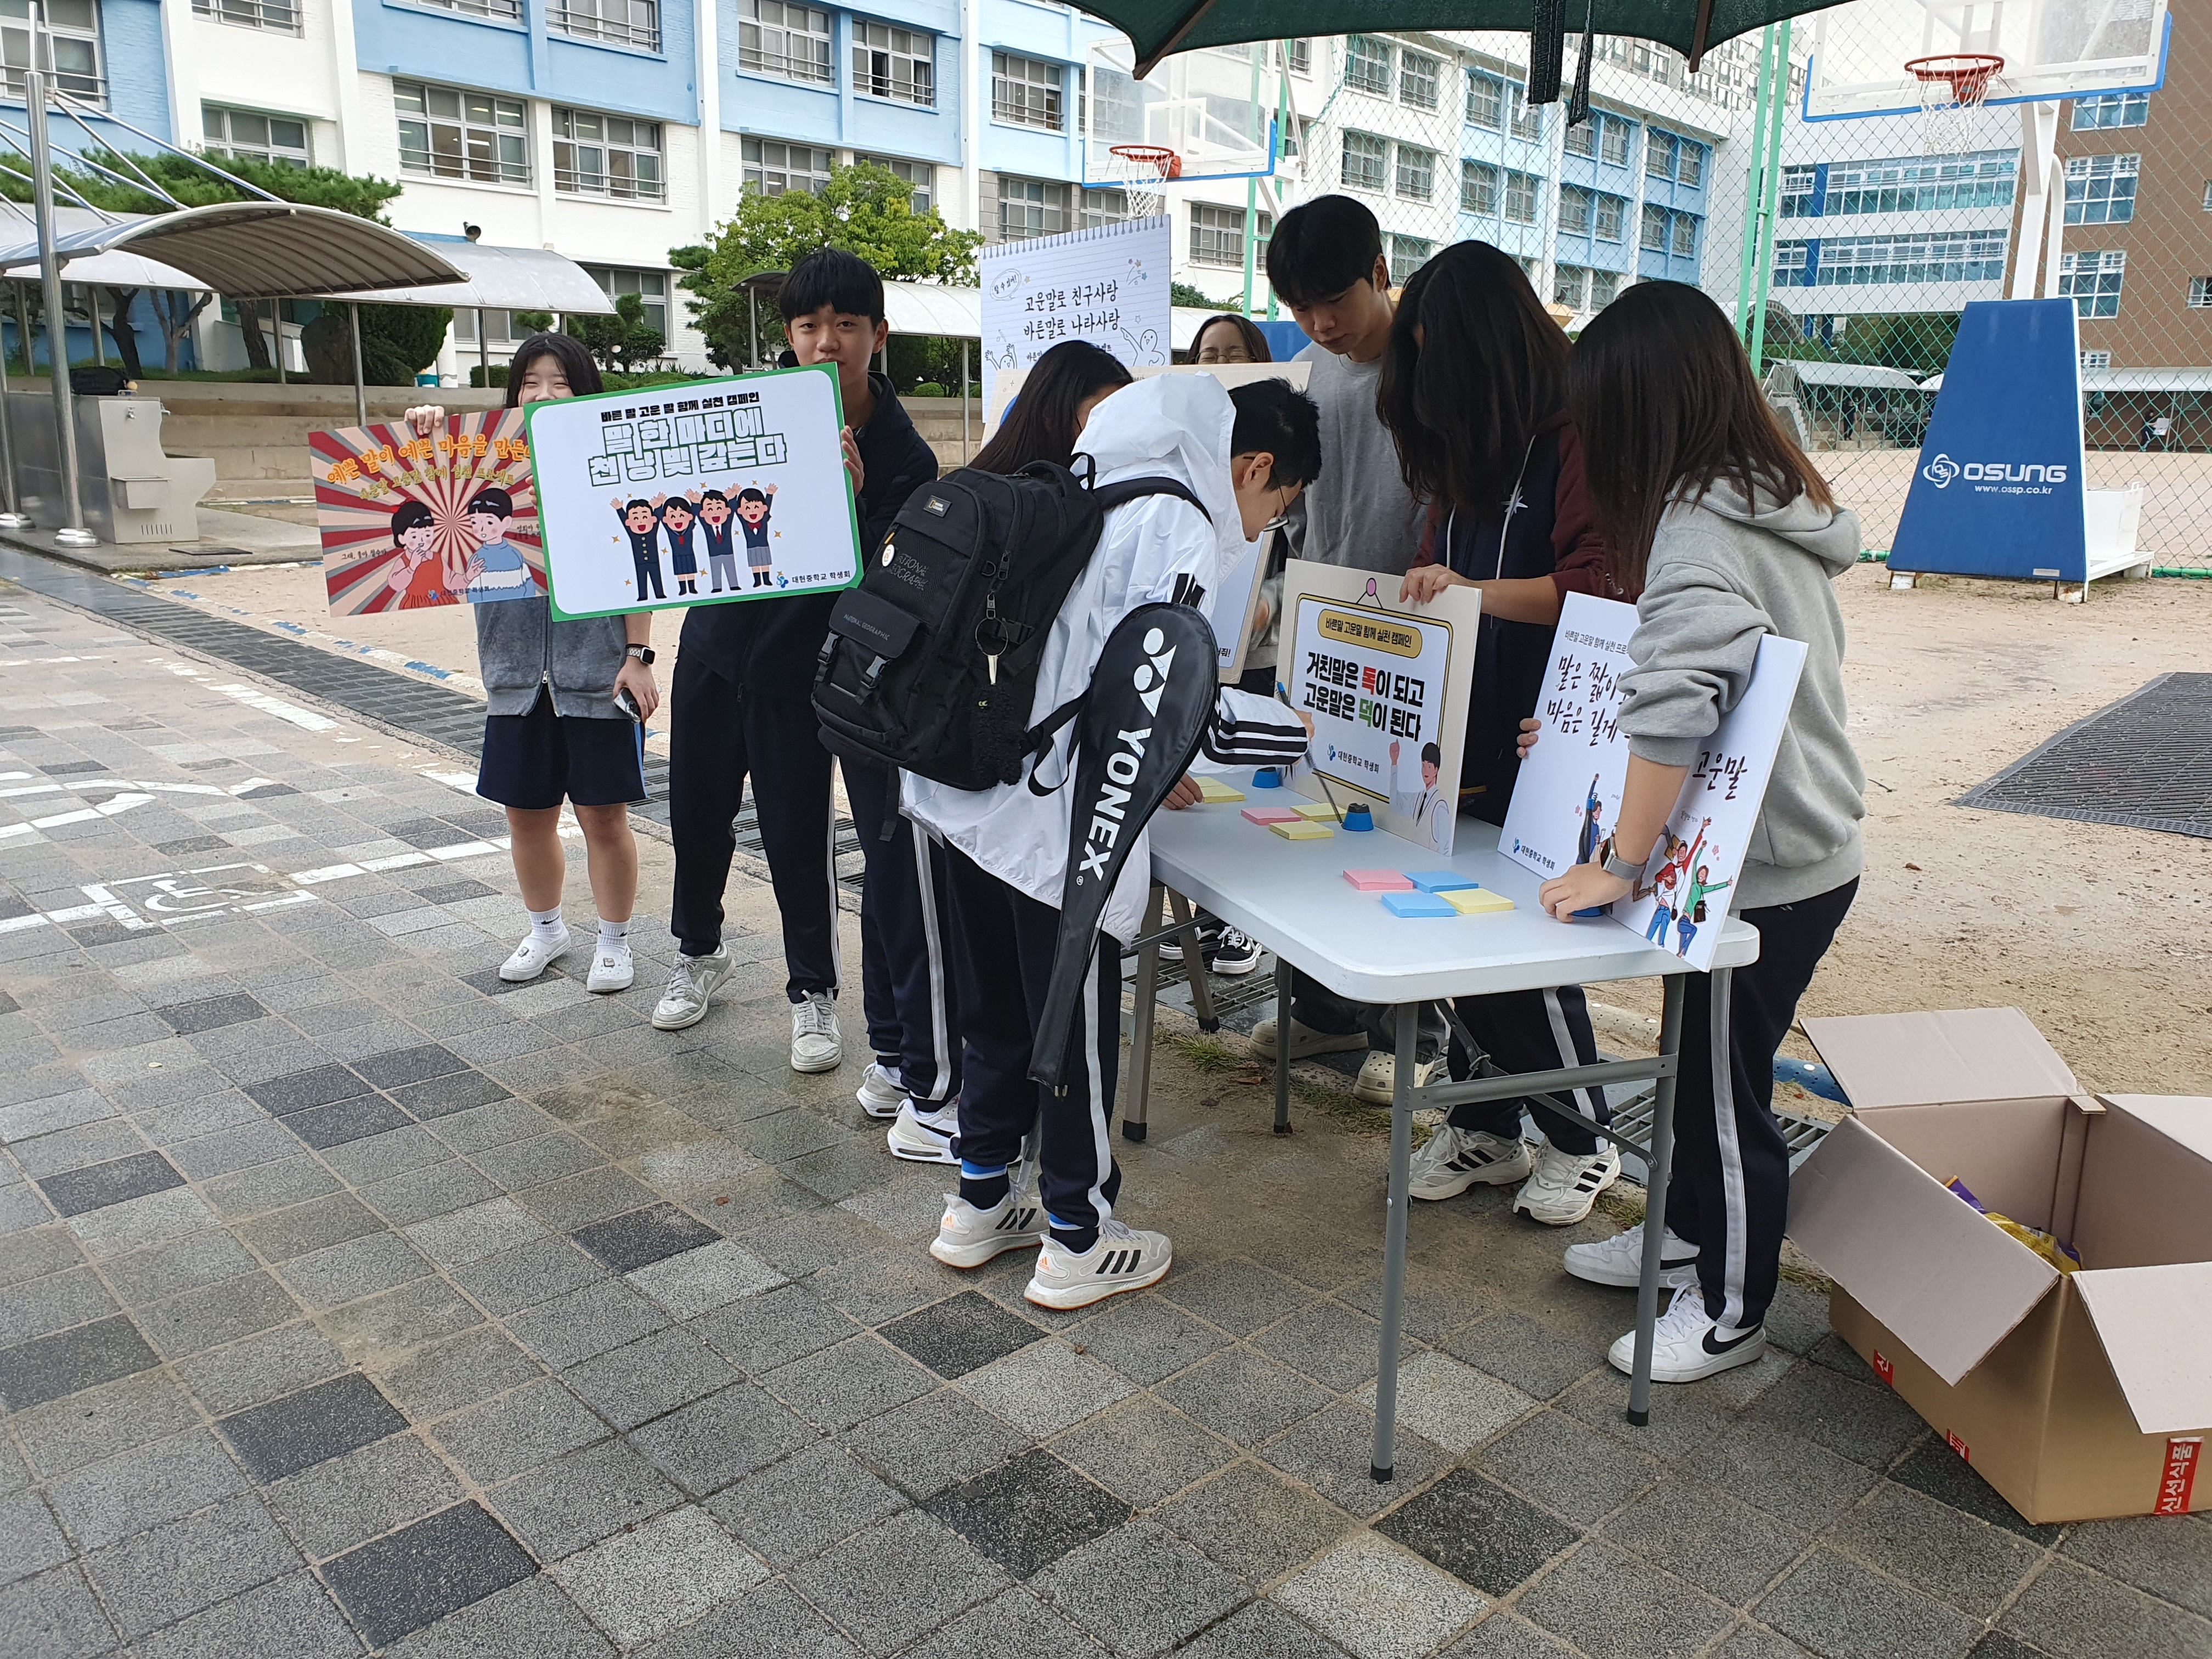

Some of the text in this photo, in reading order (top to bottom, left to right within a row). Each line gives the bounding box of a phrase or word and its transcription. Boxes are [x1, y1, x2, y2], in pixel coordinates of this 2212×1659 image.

[1024, 279, 1119, 312] 고운말로 친구사랑
[1024, 308, 1120, 341] 바른말로 나라사랑
[601, 409, 622, 422] 바른
[625, 408, 637, 419] 말
[663, 403, 674, 414] 말
[676, 400, 699, 412] 함께
[702, 396, 724, 409] 실천
[726, 392, 760, 406] 캠페인
[602, 406, 765, 455] 말 한 마디에
[326, 458, 360, 485] 예쁜
[359, 444, 394, 474] 말이
[398, 438, 434, 462] 예쁜
[437, 433, 488, 459] 마음을
[424, 464, 449, 482] 함께
[450, 464, 473, 481] 실천
[475, 466, 515, 486] 프로젝트
[588, 455, 621, 487] 천
[624, 449, 657, 482] 냥
[697, 433, 787, 474] 갚는다
[1963, 462, 2068, 483] OSUNG
[1974, 485, 2053, 495] www.ossp.co.kr
[792, 570, 851, 583] 대현중학교 학생회
[861, 622, 890, 641] GEOGRAPHIC
[1325, 617, 1412, 648] 바른말 고운말 함께 실천 캠페인
[1565, 629, 1579, 642] 바른말
[1578, 634, 1594, 646] 고운말
[1594, 637, 1605, 650] 함께
[1605, 640, 1616, 652] 실천
[1306, 652, 1425, 708] 거친말은 독이 되고
[1558, 653, 1582, 691] 말은
[1304, 682, 1421, 742] 고운말은 덕이 된다
[1338, 751, 1380, 774] 대현중학교 학생회
[1547, 698, 1748, 800] 마음은 길게 고운말
[1079, 727, 1152, 881] YONEX
[1521, 845, 1556, 871] 대현중학교 학생회
[2161, 1443, 2193, 1513] 신선식품
